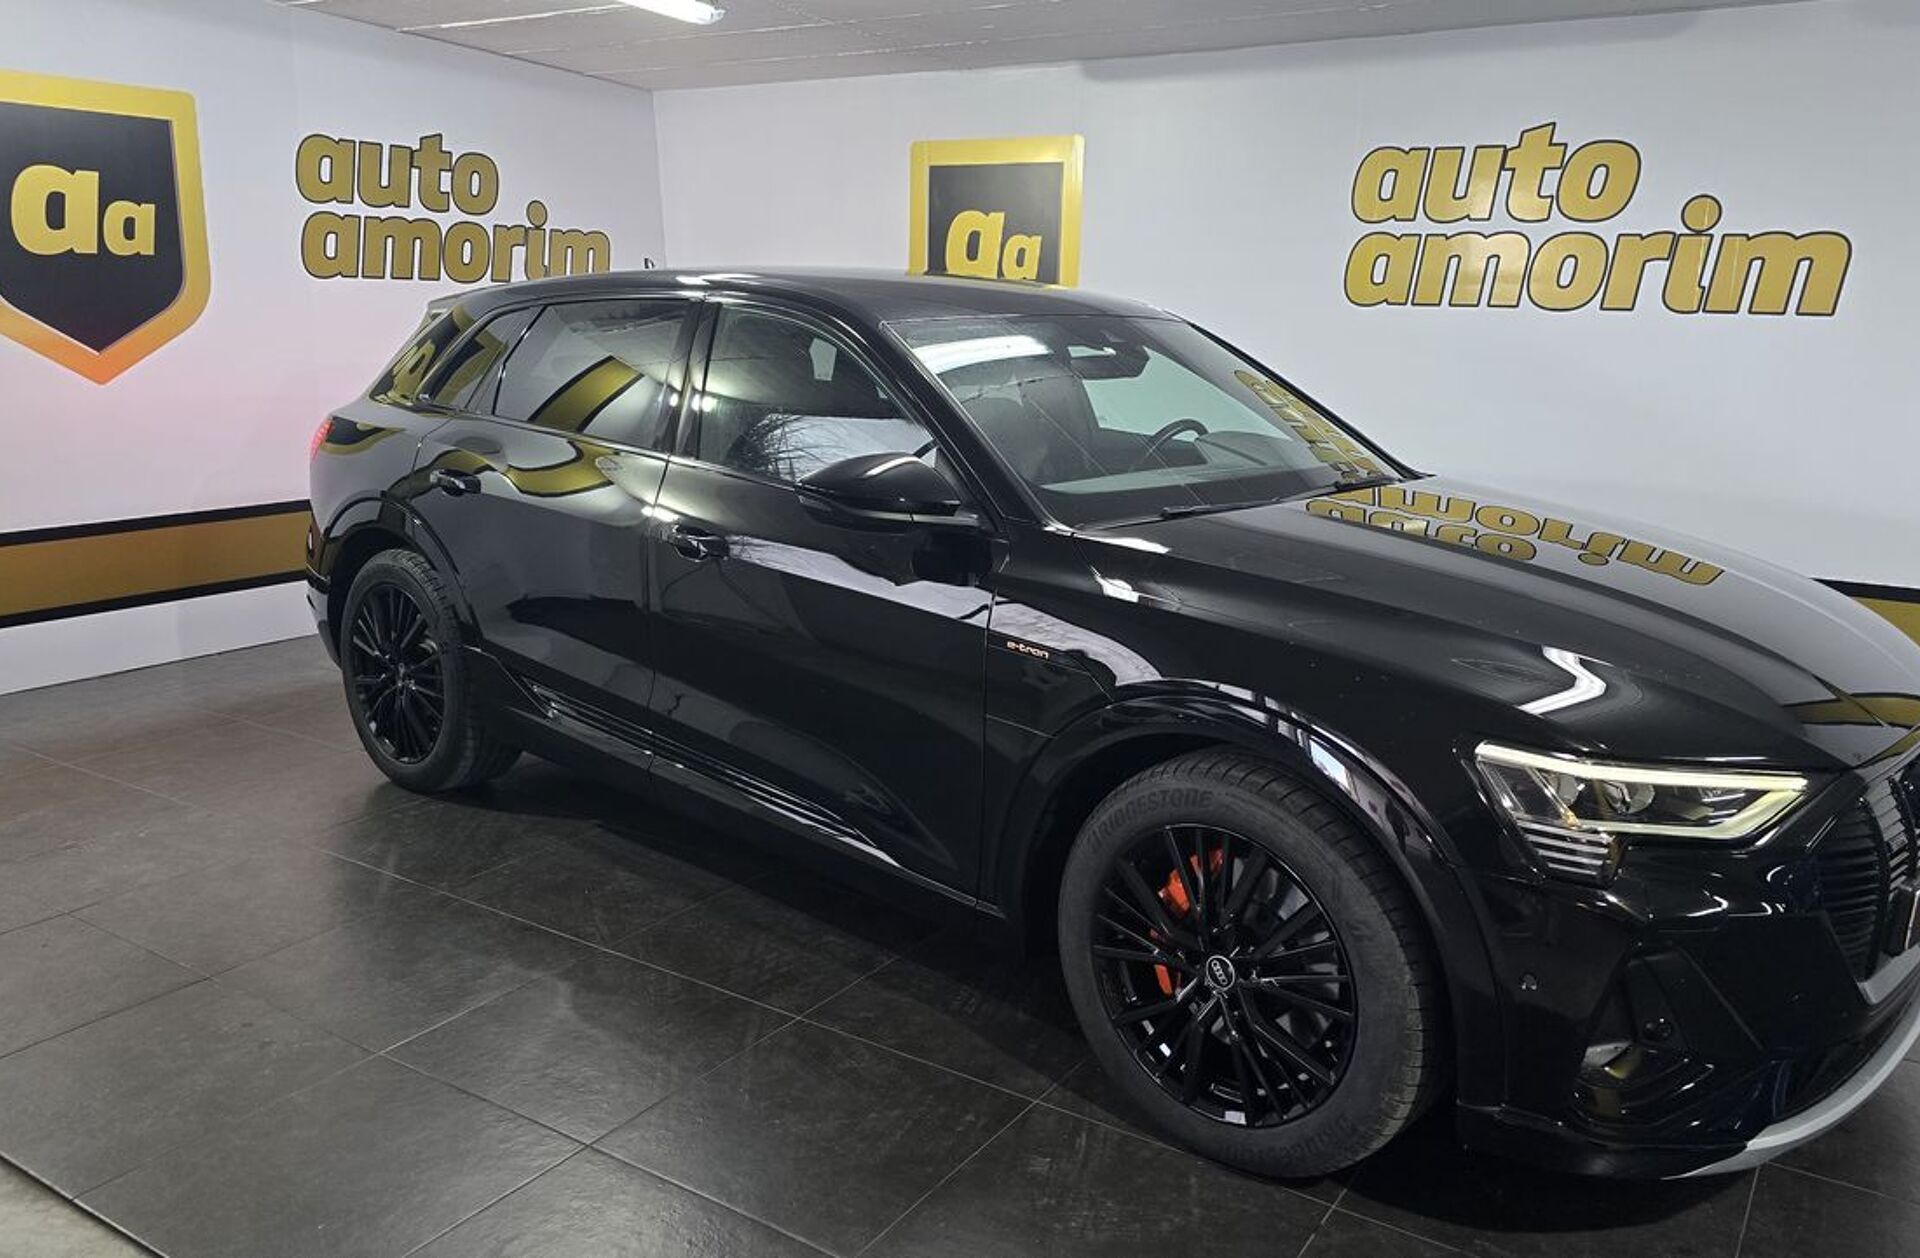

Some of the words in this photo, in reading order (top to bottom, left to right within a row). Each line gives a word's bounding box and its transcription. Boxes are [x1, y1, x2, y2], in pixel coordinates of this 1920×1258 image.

[295, 133, 499, 216] auto
[1351, 122, 1641, 222] auto
[301, 200, 611, 283] amorim
[1344, 194, 1852, 316] amorim
[1006, 641, 1050, 660] e-tron
